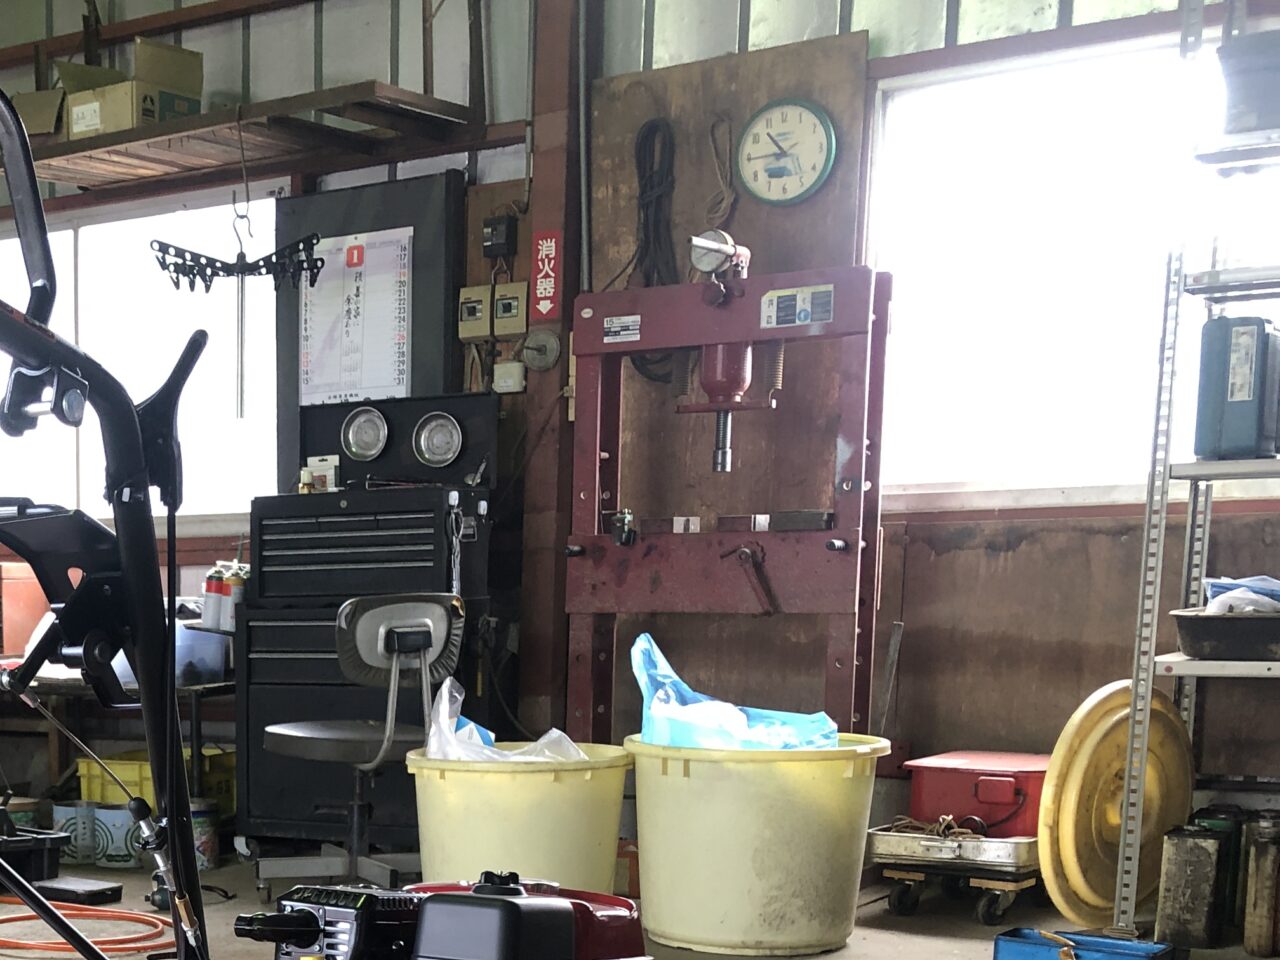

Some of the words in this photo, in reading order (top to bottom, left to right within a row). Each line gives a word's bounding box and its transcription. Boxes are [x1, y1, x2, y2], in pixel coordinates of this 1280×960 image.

[766, 117, 773, 129] 11
[781, 112, 788, 123] 12
[753, 133, 760, 144] 10
[753, 170, 759, 182] 8
[782, 183, 788, 194] 6
[352, 250, 358, 262] 1
[536, 238, 556, 298] 消火器
[606, 318, 614, 326] 15
